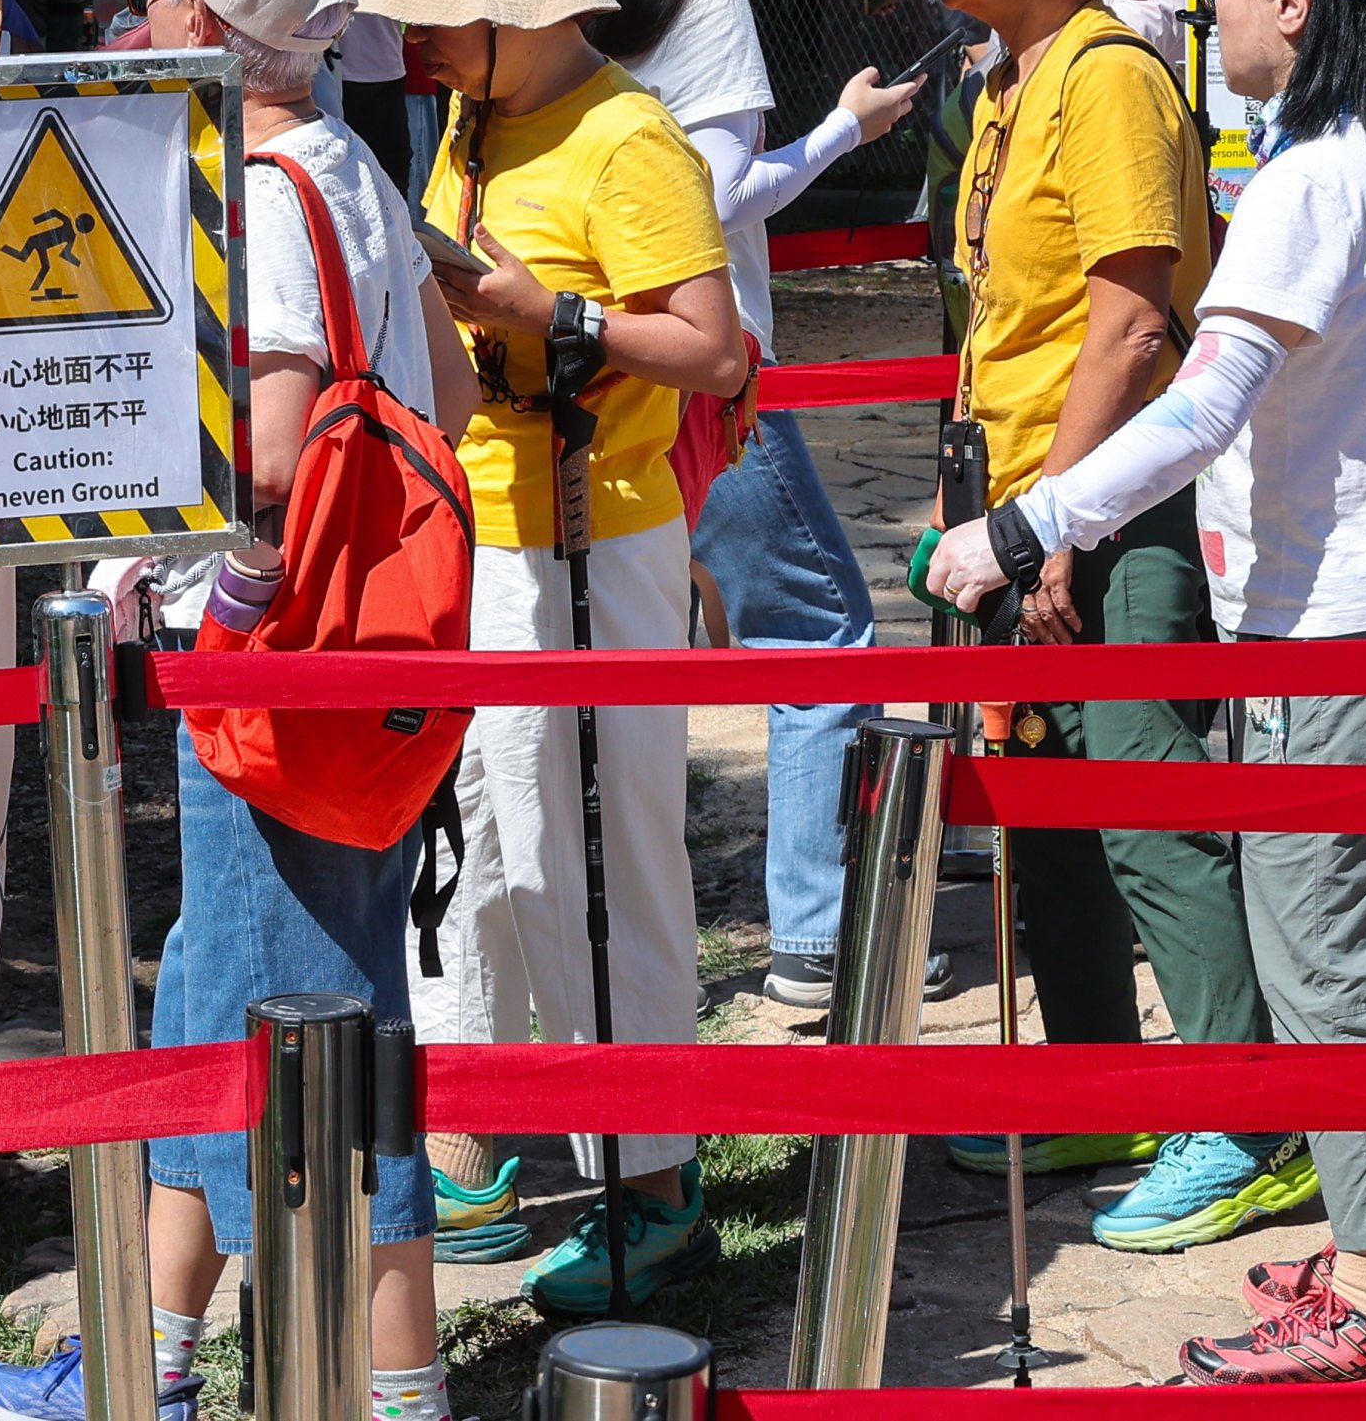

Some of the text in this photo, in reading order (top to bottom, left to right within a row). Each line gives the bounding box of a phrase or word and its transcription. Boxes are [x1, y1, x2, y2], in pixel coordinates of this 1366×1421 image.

[1211, 148, 1248, 158] ersonal
[13, 449, 114, 473] Caution:
[71, 477, 160, 503] Ground
